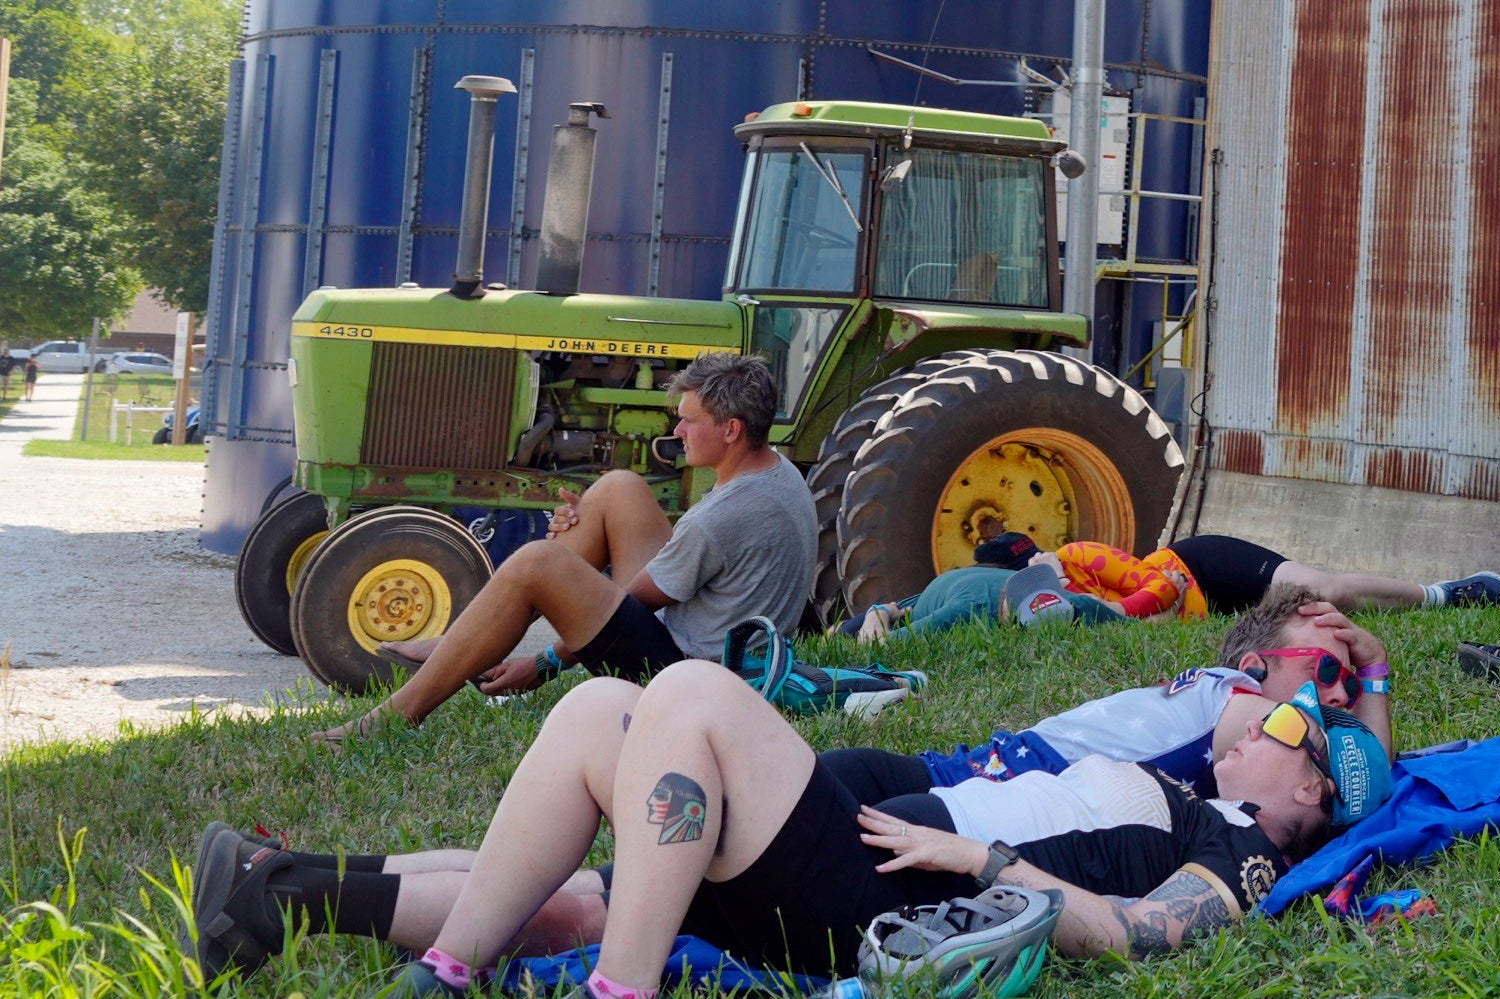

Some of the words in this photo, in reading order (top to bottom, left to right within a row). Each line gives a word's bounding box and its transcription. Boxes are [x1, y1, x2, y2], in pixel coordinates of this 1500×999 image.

[319, 325, 374, 338] 4430
[547, 339, 596, 351] JOHN
[607, 342, 669, 355] DEERE
[1357, 748, 1365, 769] NORTH
[1341, 750, 1350, 802] CHAMPIONSHIPS
[1344, 738, 1358, 768] CYCLE
[1351, 771, 1360, 813] COURIER
